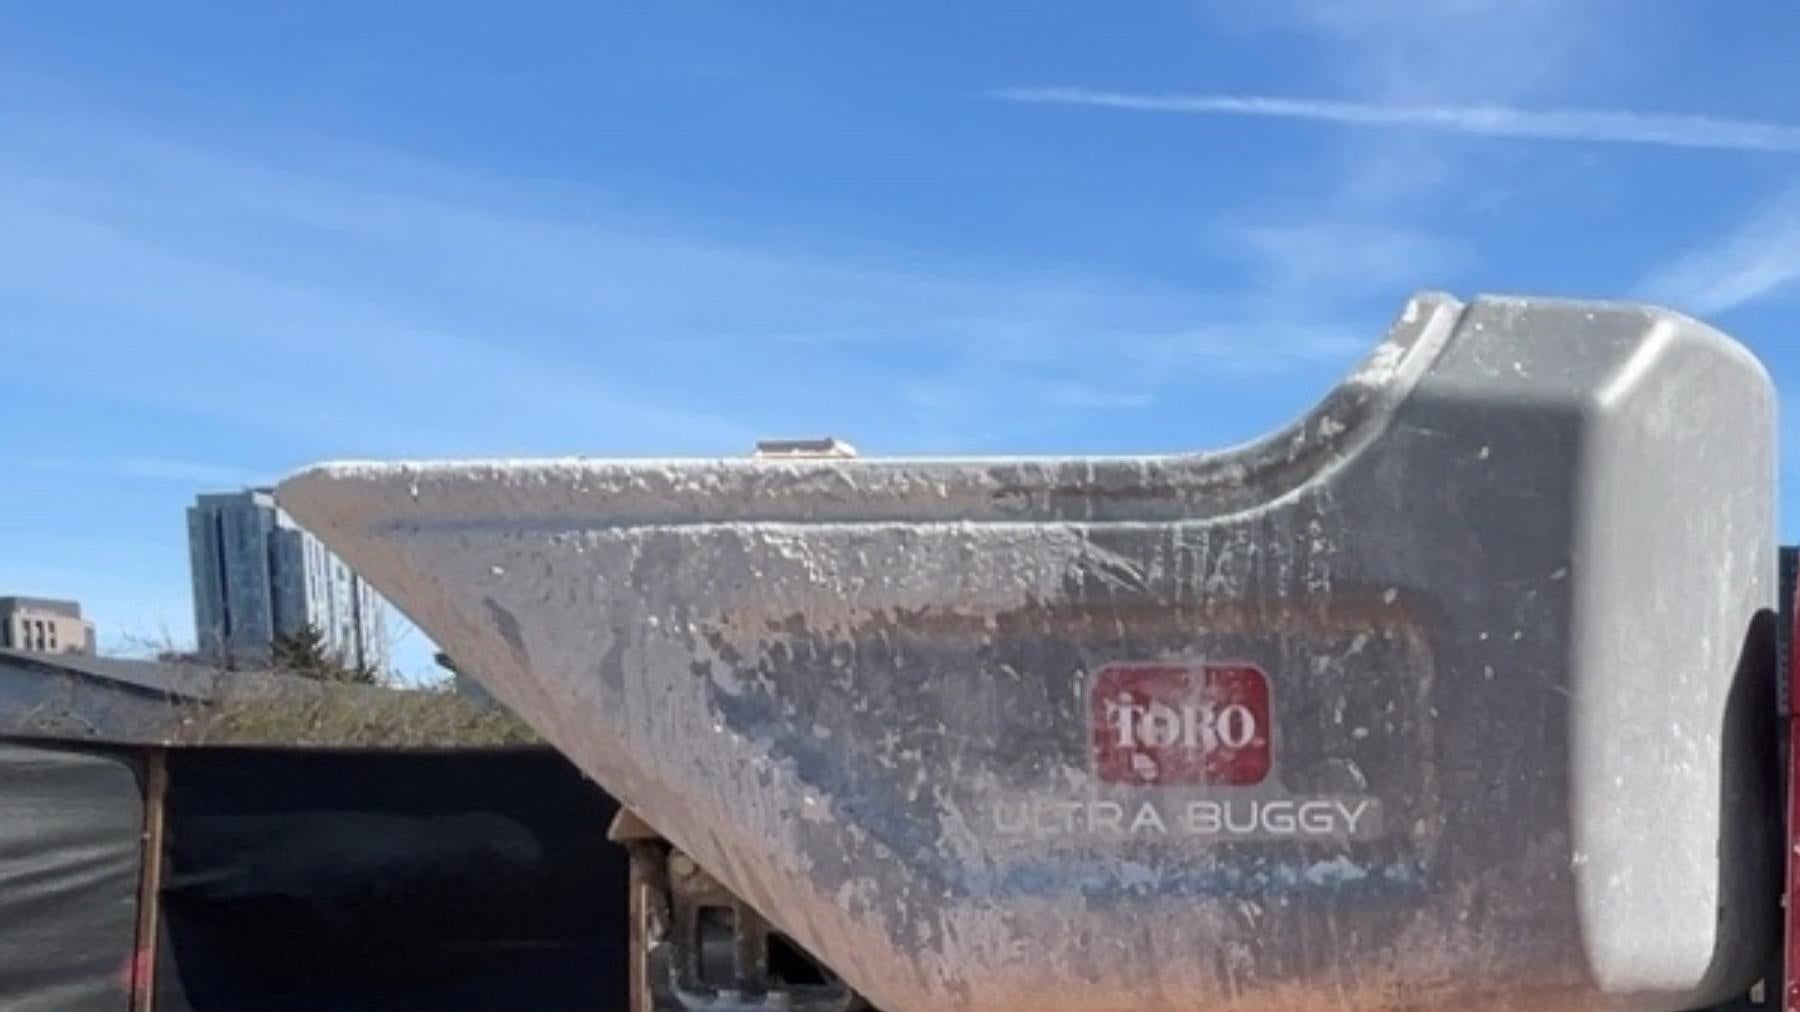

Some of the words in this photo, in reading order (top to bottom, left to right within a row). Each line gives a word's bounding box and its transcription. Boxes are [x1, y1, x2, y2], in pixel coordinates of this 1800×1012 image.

[1106, 698, 1256, 749] TORO
[994, 801, 1167, 834] ULTRA
[1186, 801, 1367, 834] BUGGY
